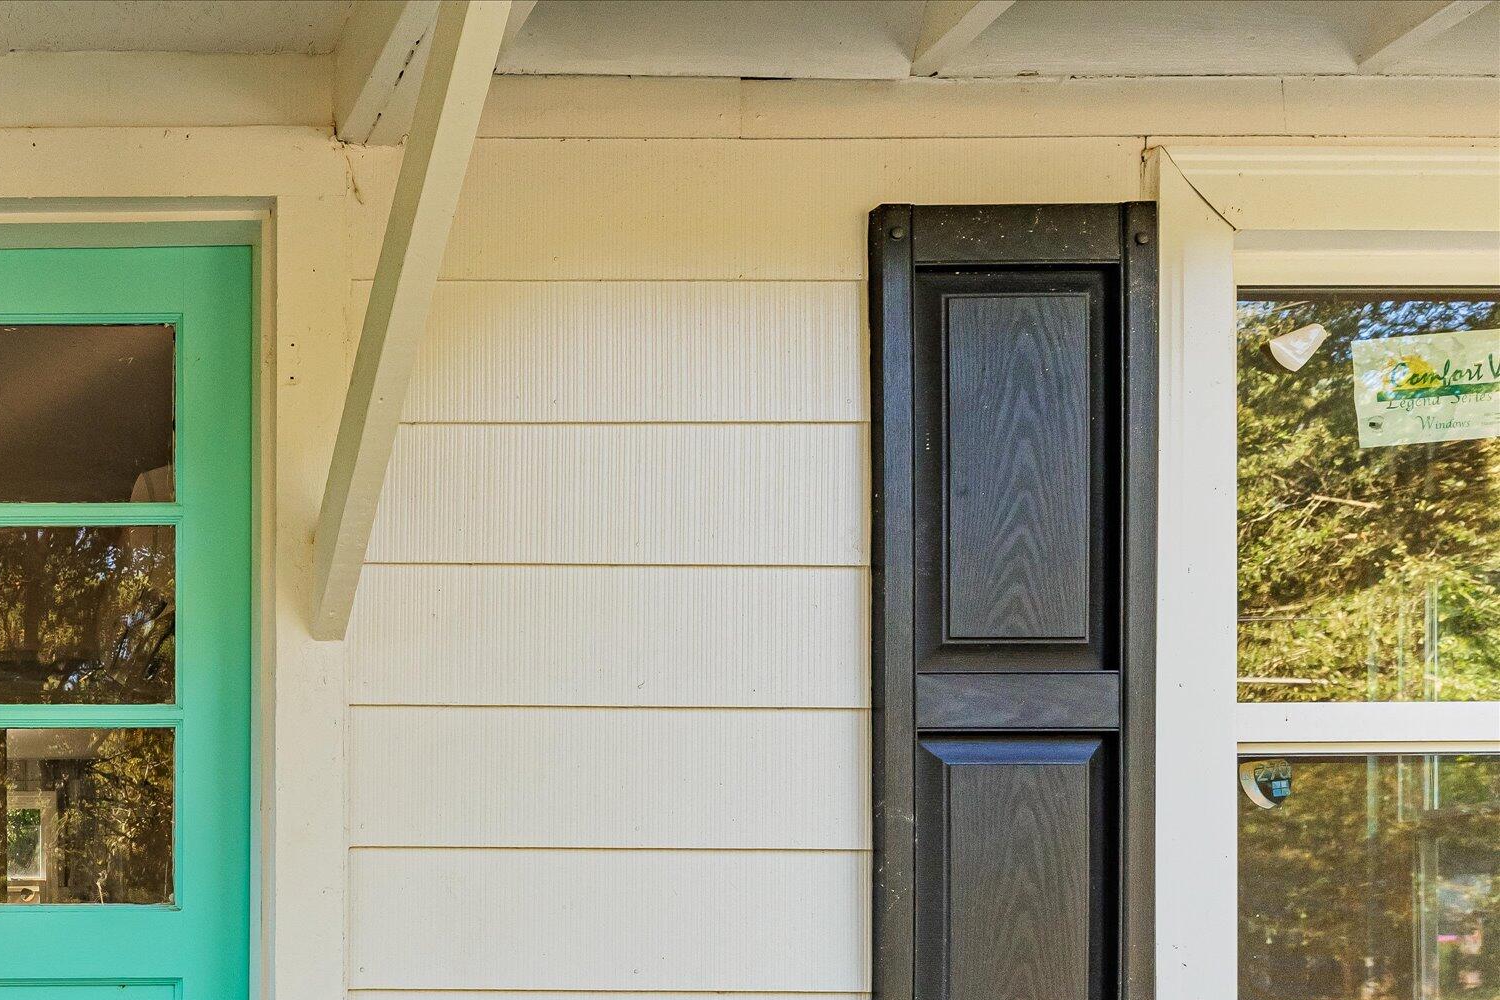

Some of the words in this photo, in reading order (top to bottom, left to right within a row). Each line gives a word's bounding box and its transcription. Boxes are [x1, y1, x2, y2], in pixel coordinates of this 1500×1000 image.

[1389, 358, 1484, 387] Comfort
[1386, 395, 1441, 412] Legend
[1451, 391, 1493, 404] Series
[1415, 415, 1471, 430] Windows
